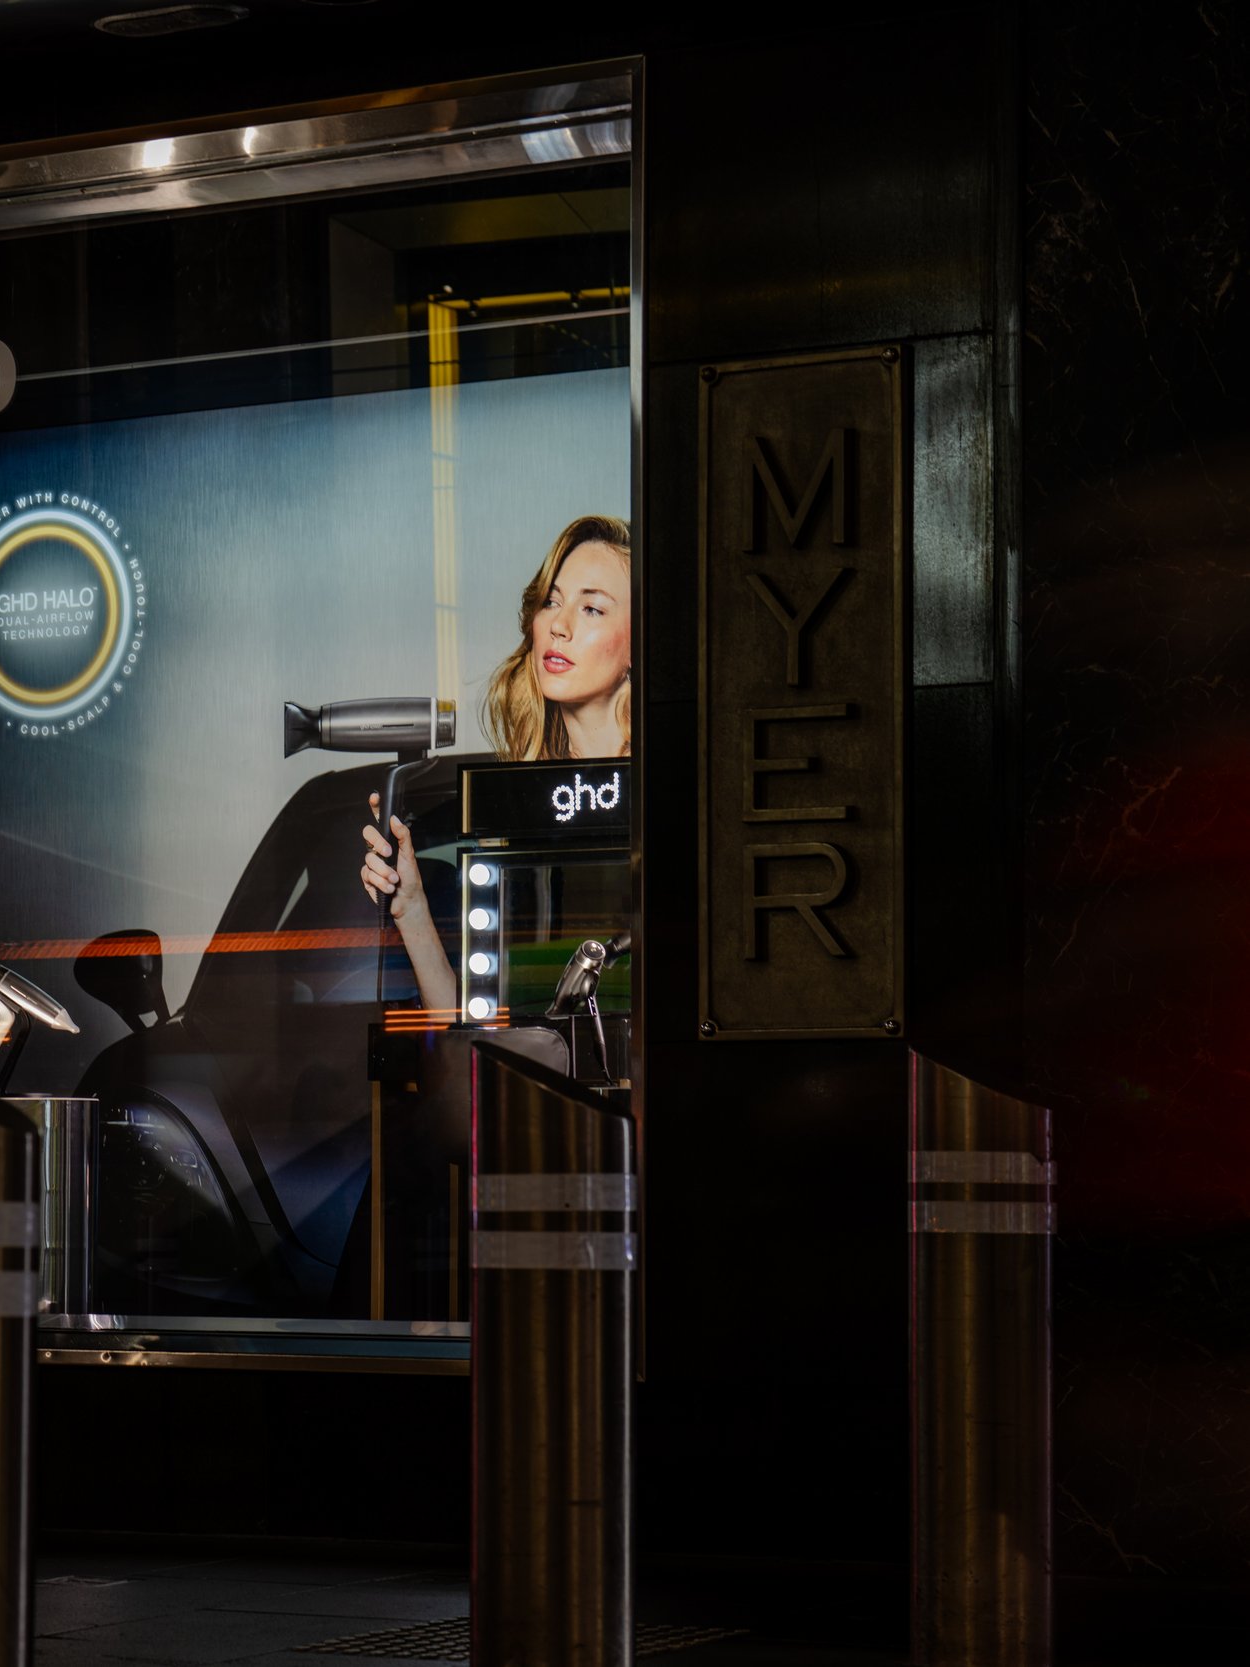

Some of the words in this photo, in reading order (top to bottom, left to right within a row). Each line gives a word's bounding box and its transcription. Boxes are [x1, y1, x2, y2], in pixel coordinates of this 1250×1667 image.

[16, 492, 53, 509] WITH
[61, 493, 121, 538] CONTROL
[2, 624, 89, 641] TECHNOLOGY
[20, 695, 111, 737] COOL-SCALP
[123, 558, 146, 676] COOL-TOUCH
[745, 428, 857, 962] MYER
[551, 771, 621, 821] ghd
